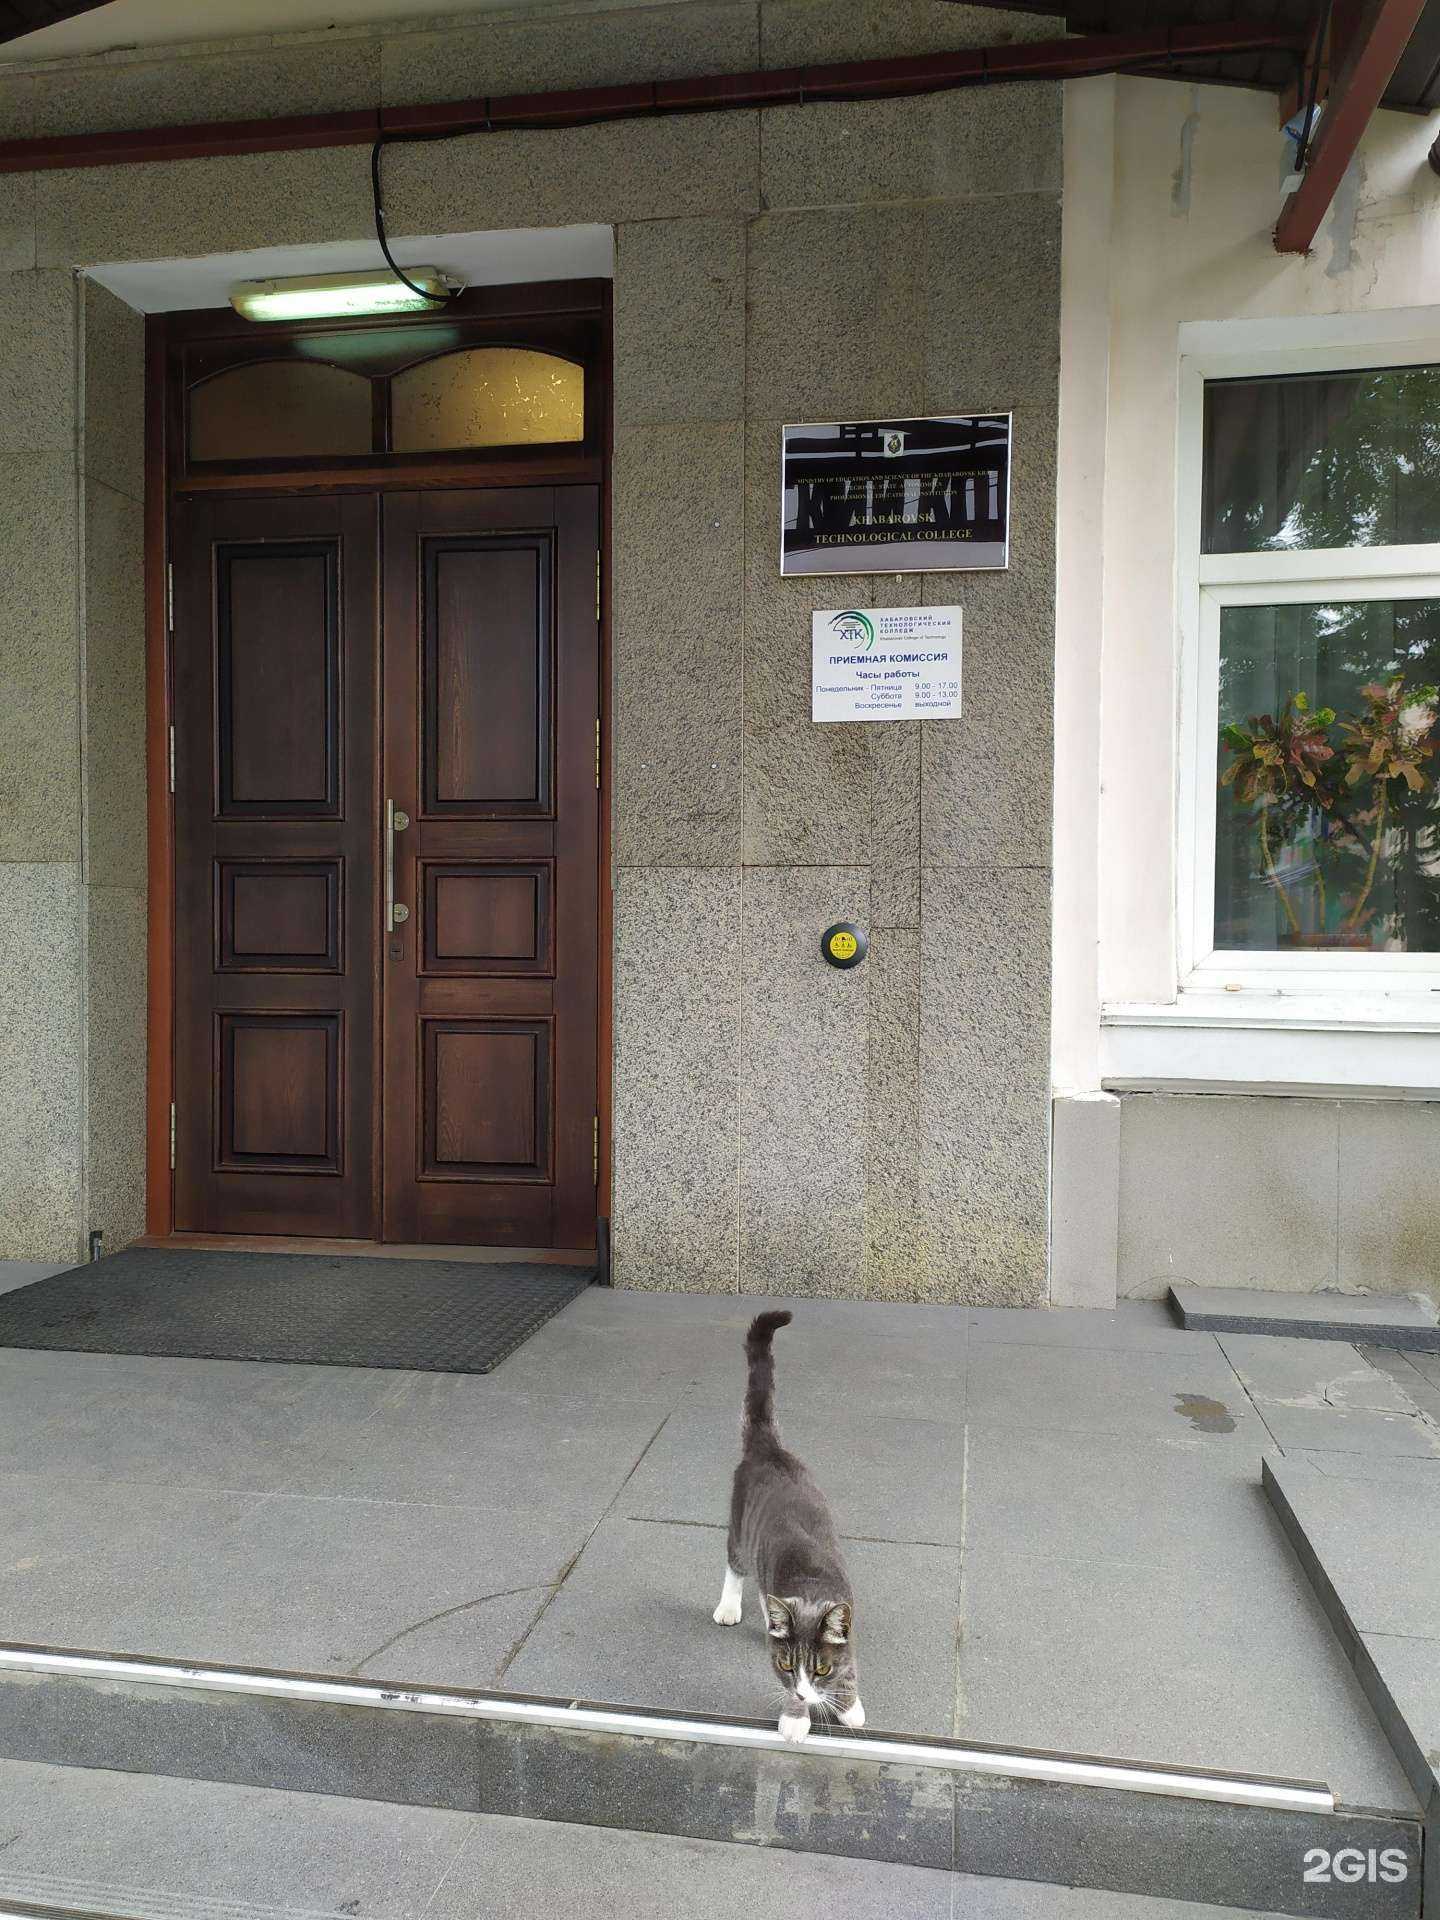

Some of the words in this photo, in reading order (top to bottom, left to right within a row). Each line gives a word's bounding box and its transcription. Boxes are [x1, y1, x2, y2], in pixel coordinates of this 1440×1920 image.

[854, 512, 934, 525] KHABAROVSK
[815, 531, 915, 544] TECHNOLOGICAL
[917, 528, 973, 540] COLLEGE
[880, 614, 933, 622] ХАБАРОВСКИЙ
[880, 620, 951, 628] ТЕХНОЛОГИЧЕСКИЙ
[840, 629, 864, 641] ХТК
[830, 654, 886, 664] ПРИЕМНАЯ
[889, 653, 948, 663] КОМИССИЯ
[856, 671, 882, 679] Часы
[884, 670, 920, 680] работы
[816, 685, 864, 693] Понедельник
[870, 684, 903, 692] Пятница
[914, 682, 931, 690] 9.00
[870, 692, 903, 701] Суббота
[914, 691, 931, 699] 9.00
[854, 702, 903, 711] Воскресенье
[914, 700, 952, 709] выходной
